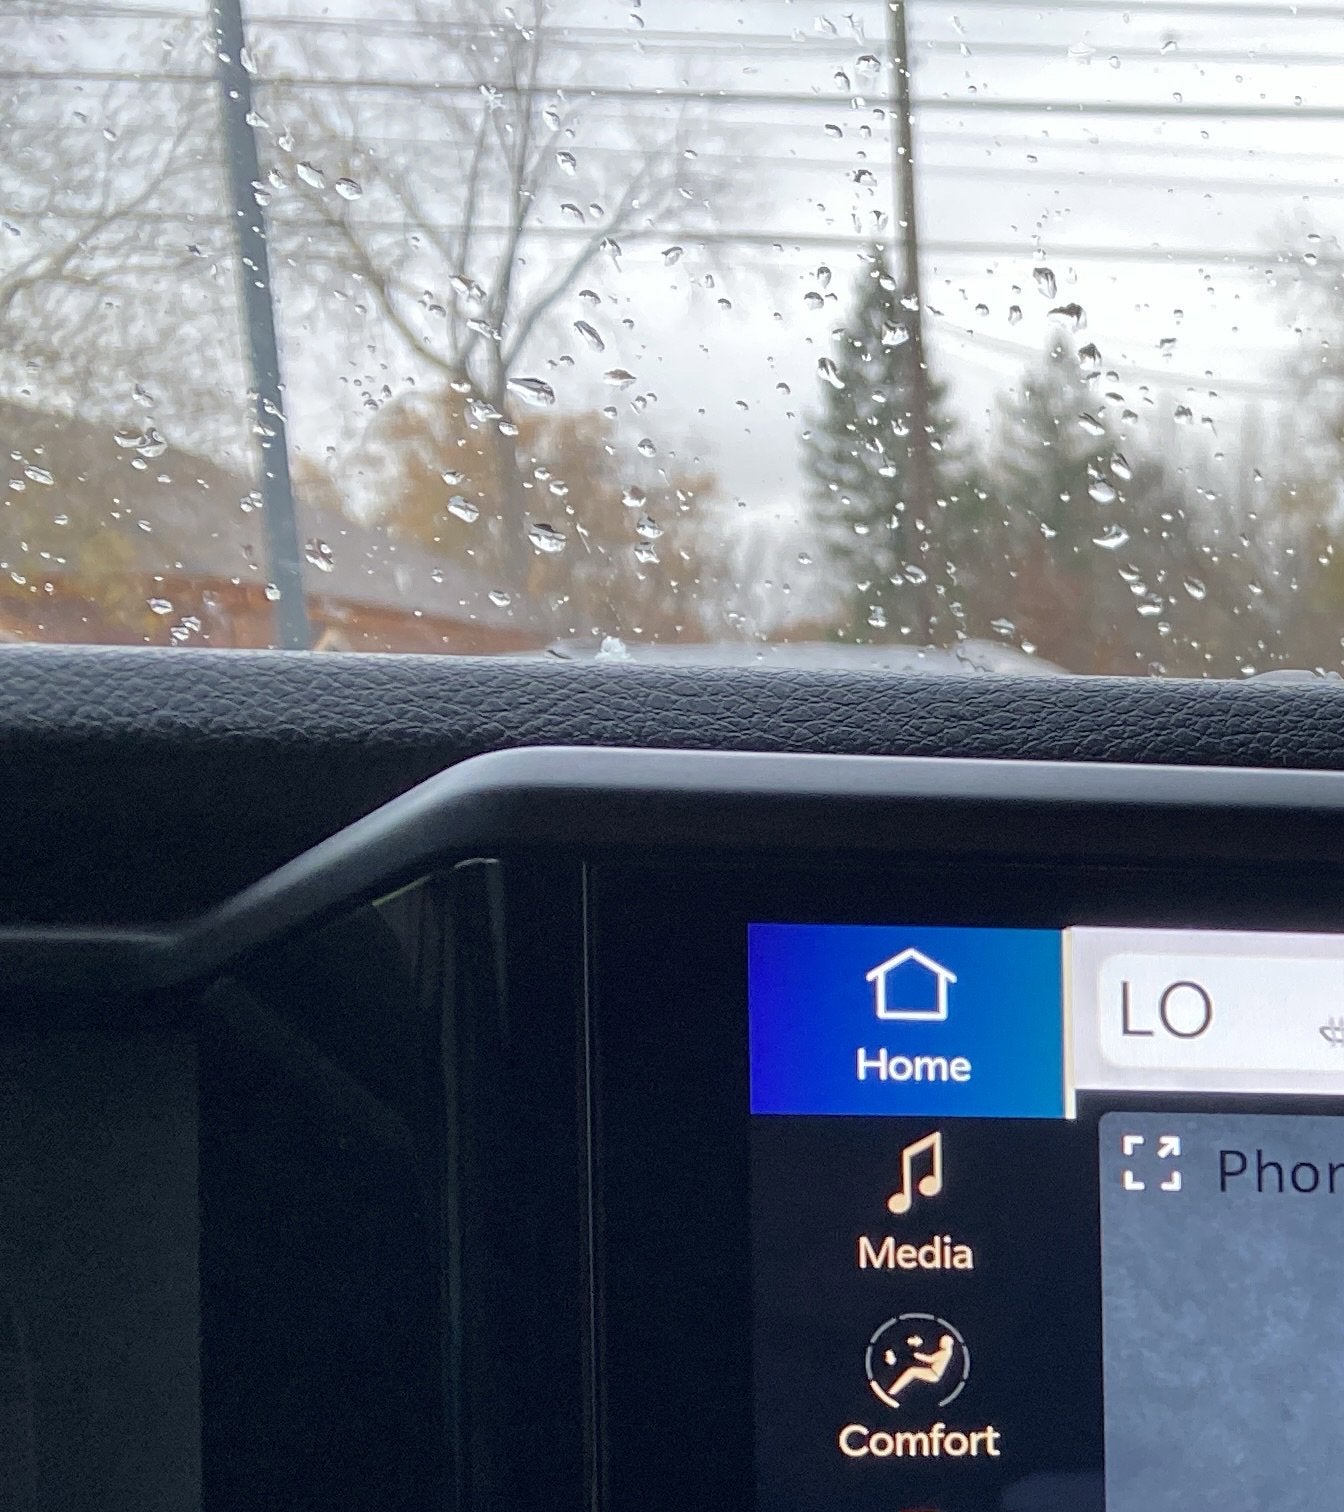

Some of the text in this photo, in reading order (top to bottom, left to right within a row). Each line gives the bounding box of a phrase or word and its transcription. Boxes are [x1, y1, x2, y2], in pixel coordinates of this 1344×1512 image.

[1120, 979, 1213, 1040] LO
[856, 1047, 972, 1083] Home
[858, 1235, 974, 1271] Media
[838, 1422, 1000, 1458] Comfort
